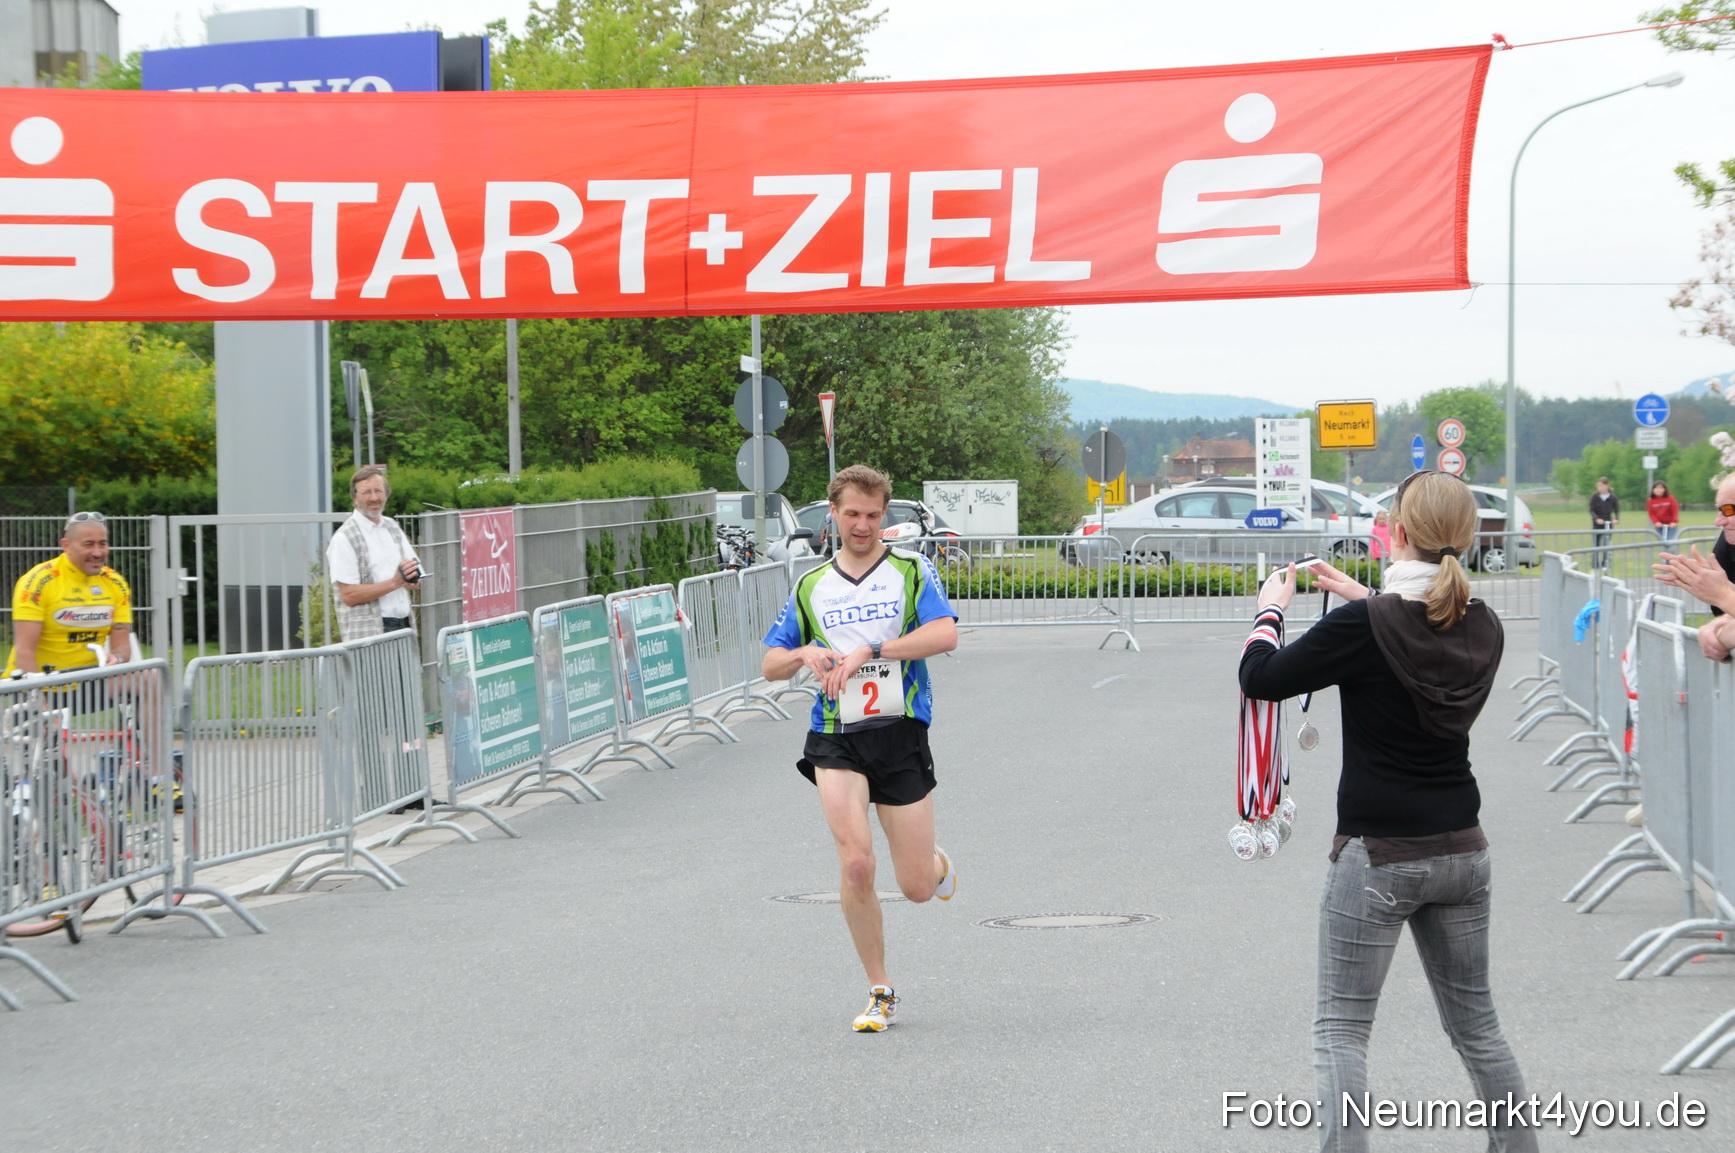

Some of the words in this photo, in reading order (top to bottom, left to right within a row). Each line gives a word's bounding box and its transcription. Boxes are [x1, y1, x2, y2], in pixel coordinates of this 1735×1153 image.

[1324, 419, 1370, 431] Neumarkt
[1444, 427, 1459, 440] 60
[1252, 517, 1279, 527] VOLVO
[470, 562, 511, 599] ZEITLOS
[823, 594, 857, 607] TEAM
[56, 609, 109, 622] Mercatone
[822, 600, 899, 629] BOCK
[862, 681, 881, 716] 2
